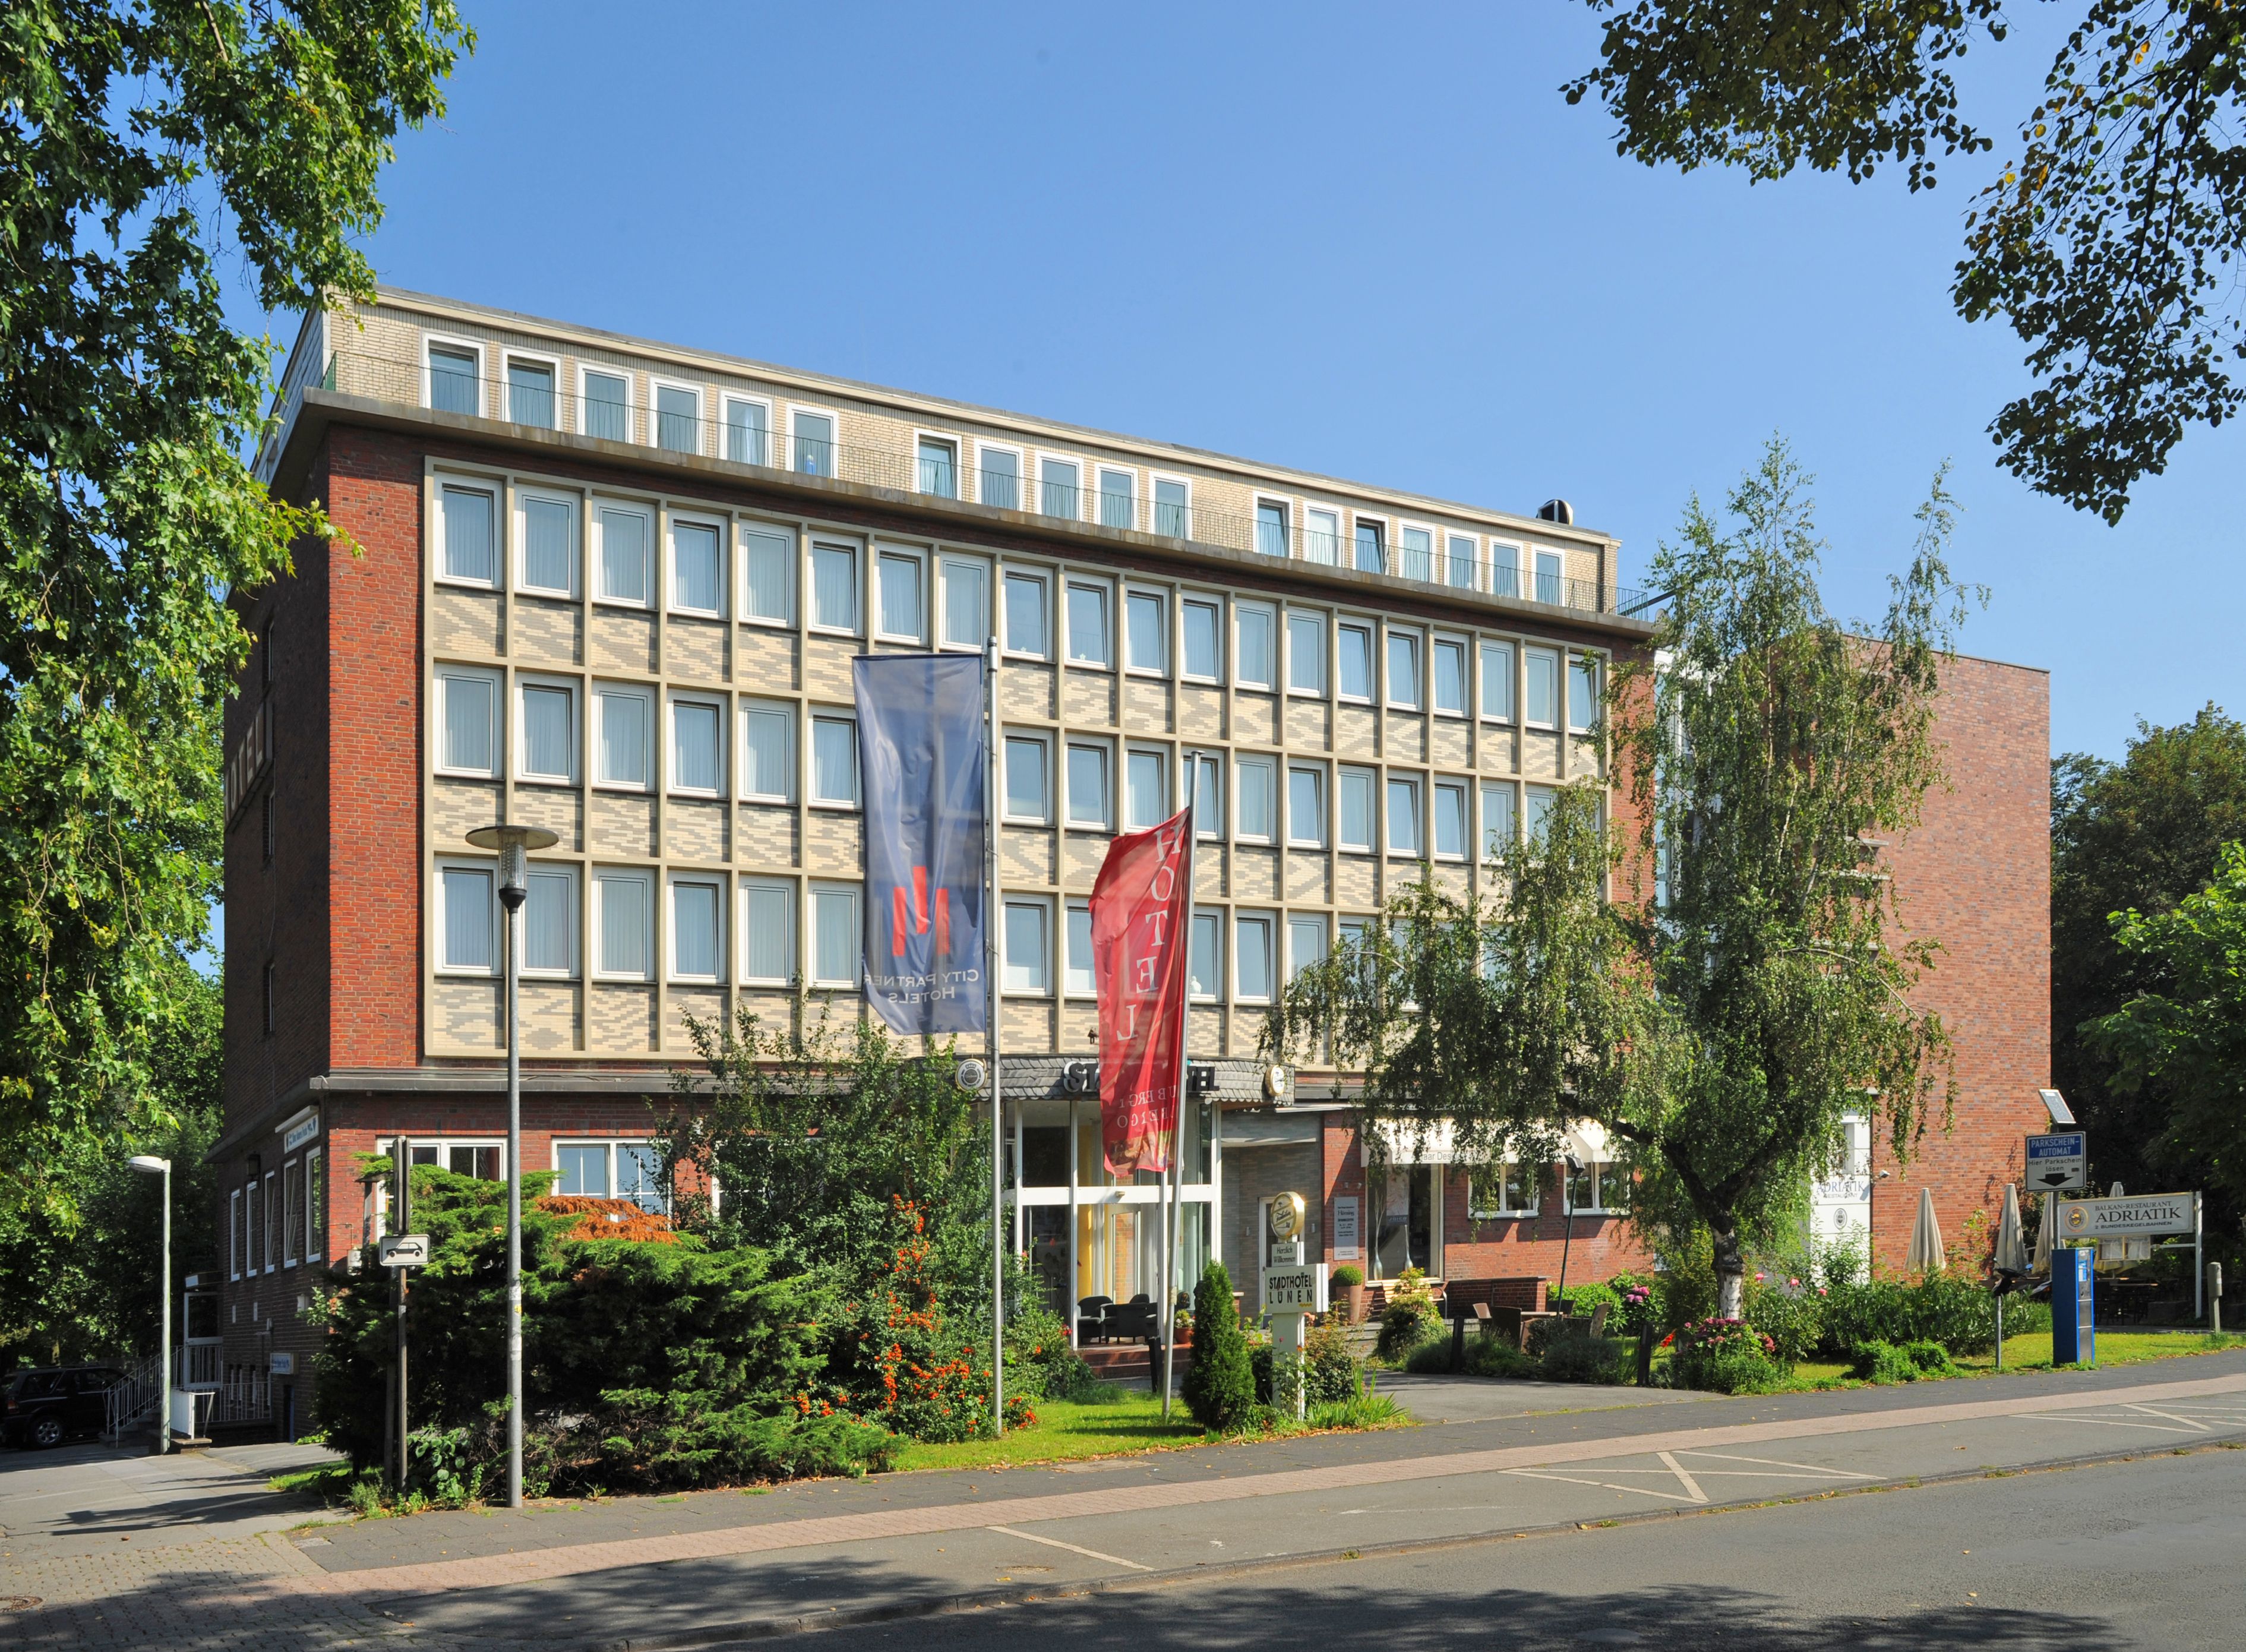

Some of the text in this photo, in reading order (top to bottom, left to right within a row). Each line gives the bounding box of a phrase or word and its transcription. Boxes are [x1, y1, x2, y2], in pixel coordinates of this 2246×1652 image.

[2032, 1137, 2080, 1148] PARKSCHEIN-
[2039, 1146, 2071, 1157] AUTOMAT
[2095, 1201, 2172, 1211] BALKAN-RESTAURANT
[2096, 1207, 2182, 1223] ADRIATIK
[2100, 1221, 2172, 1229] BUNDESKEGELBAHNEN
[1269, 1274, 1312, 1291] STADTHOTEL
